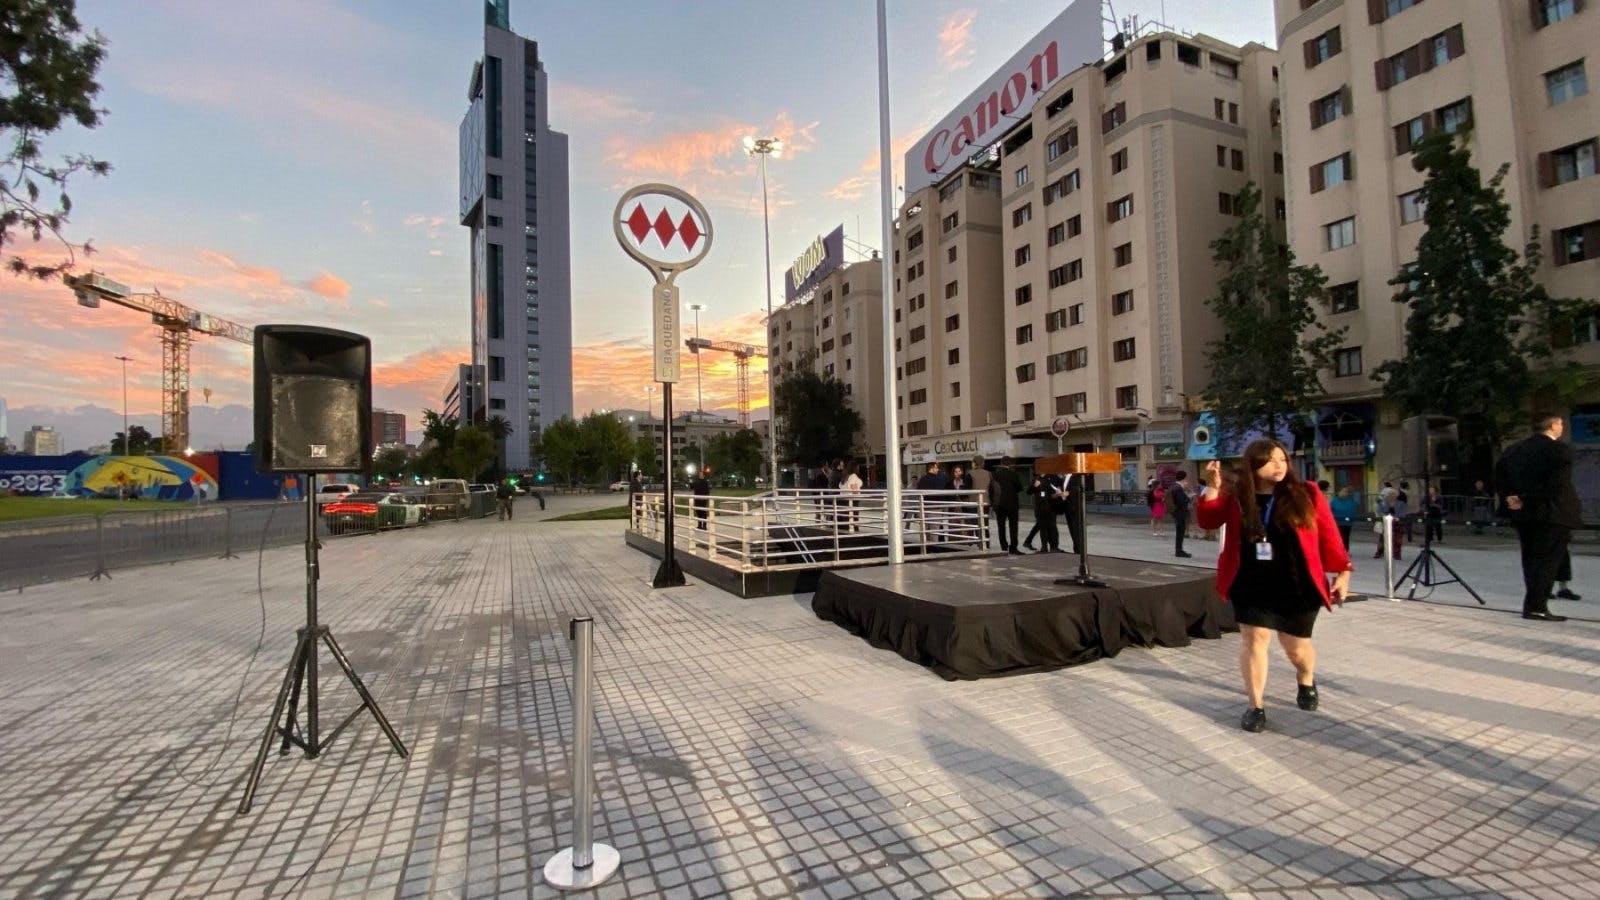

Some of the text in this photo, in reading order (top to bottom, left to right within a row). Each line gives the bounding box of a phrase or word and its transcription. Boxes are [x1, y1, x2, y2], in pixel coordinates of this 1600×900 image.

[924, 40, 1058, 174] Canon
[663, 288, 673, 365] BAQUEDANO
[11, 474, 67, 492] 2023
